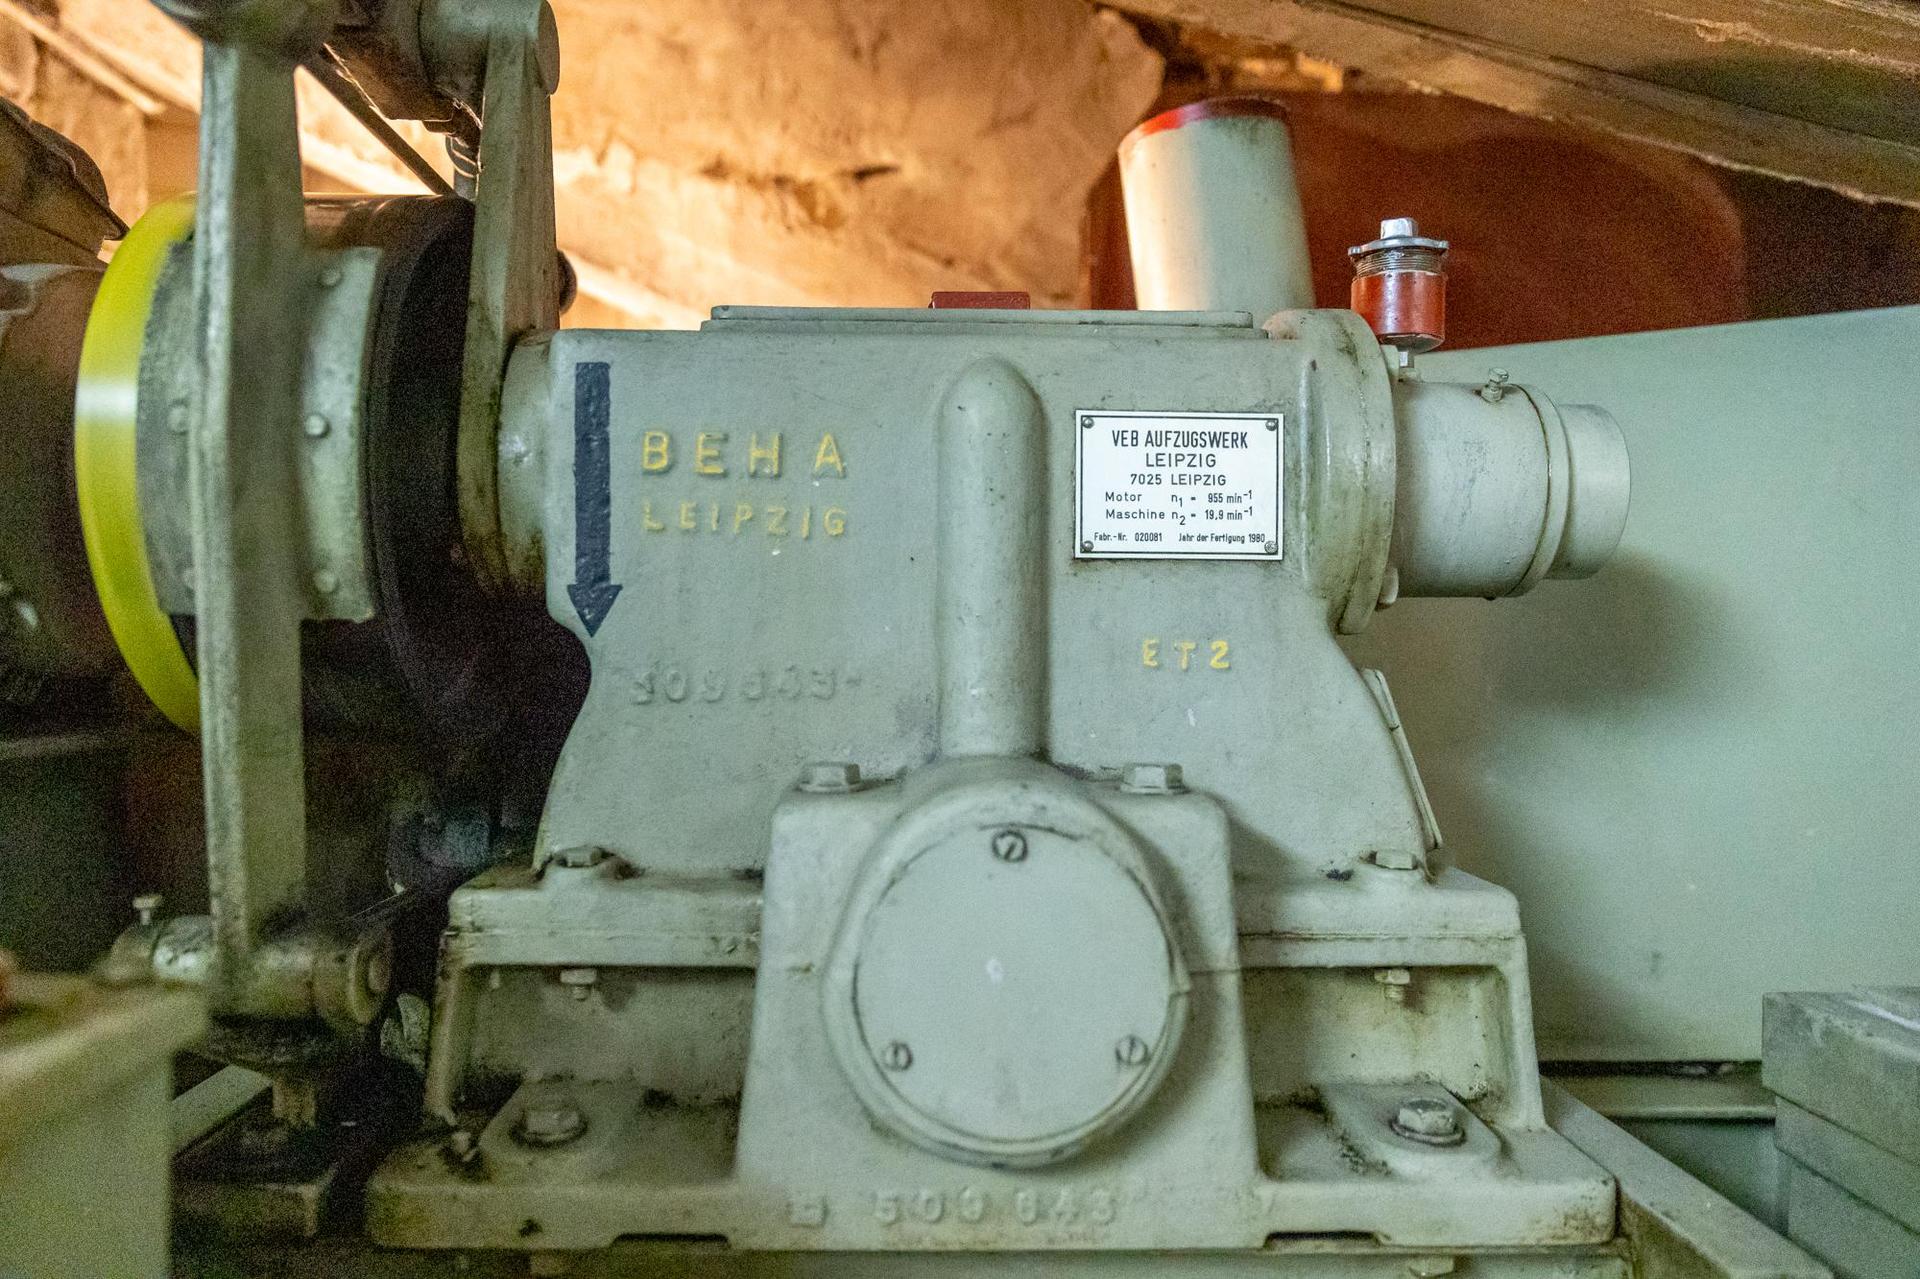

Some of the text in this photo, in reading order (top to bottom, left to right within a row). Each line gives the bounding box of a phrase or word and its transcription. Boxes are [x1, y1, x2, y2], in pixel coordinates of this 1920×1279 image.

[1112, 430, 1248, 448] VEB AUFZUGSWERK
[642, 431, 847, 479] BEHA
[1146, 453, 1216, 467] LEIPZIG
[1131, 474, 1226, 486] 7025 LEIPZIG
[1106, 492, 1142, 501] Motor
[1208, 493, 1223, 503] 955
[643, 500, 847, 540] LEIPZIG
[1106, 509, 1165, 519] Maschine
[1205, 509, 1223, 520] 19,9
[1135, 532, 1162, 541] 020081
[1179, 533, 1194, 541] Jahr
[1197, 534, 1208, 542] der
[1211, 533, 1245, 544] Fertigung
[1249, 533, 1265, 543] 1980
